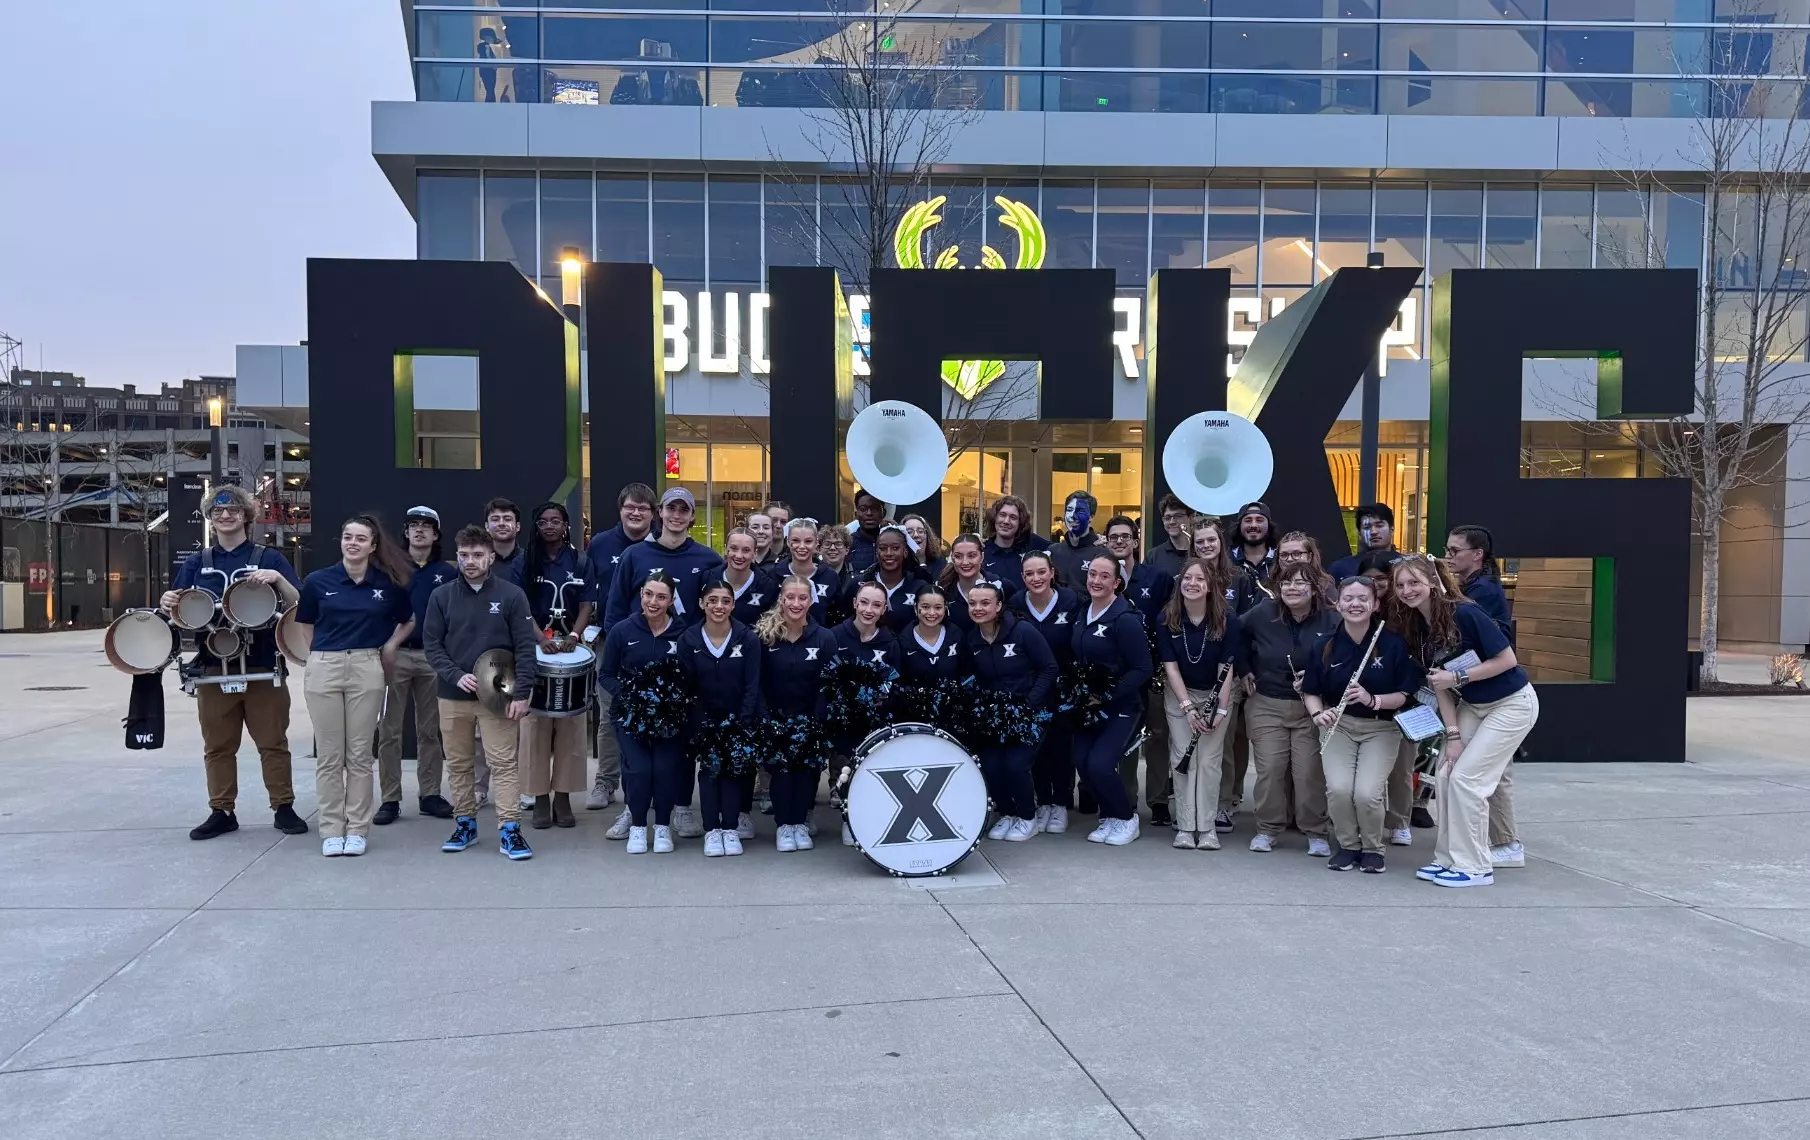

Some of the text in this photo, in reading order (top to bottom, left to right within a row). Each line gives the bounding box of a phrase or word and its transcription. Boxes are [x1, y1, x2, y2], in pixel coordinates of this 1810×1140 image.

[882, 409, 906, 417] YAMAHA
[1204, 419, 1230, 428] YAMAHA
[372, 589, 384, 598] X
[1141, 588, 1150, 596] X
[748, 593, 764, 606] X
[489, 602, 501, 611] X
[1054, 612, 1069, 624] X
[1093, 624, 1108, 638] X
[730, 644, 743, 658] X
[805, 648, 820, 660] X
[1003, 644, 1018, 658] X
[554, 685, 564, 710] YAMAHA
[866, 762, 968, 848] X
